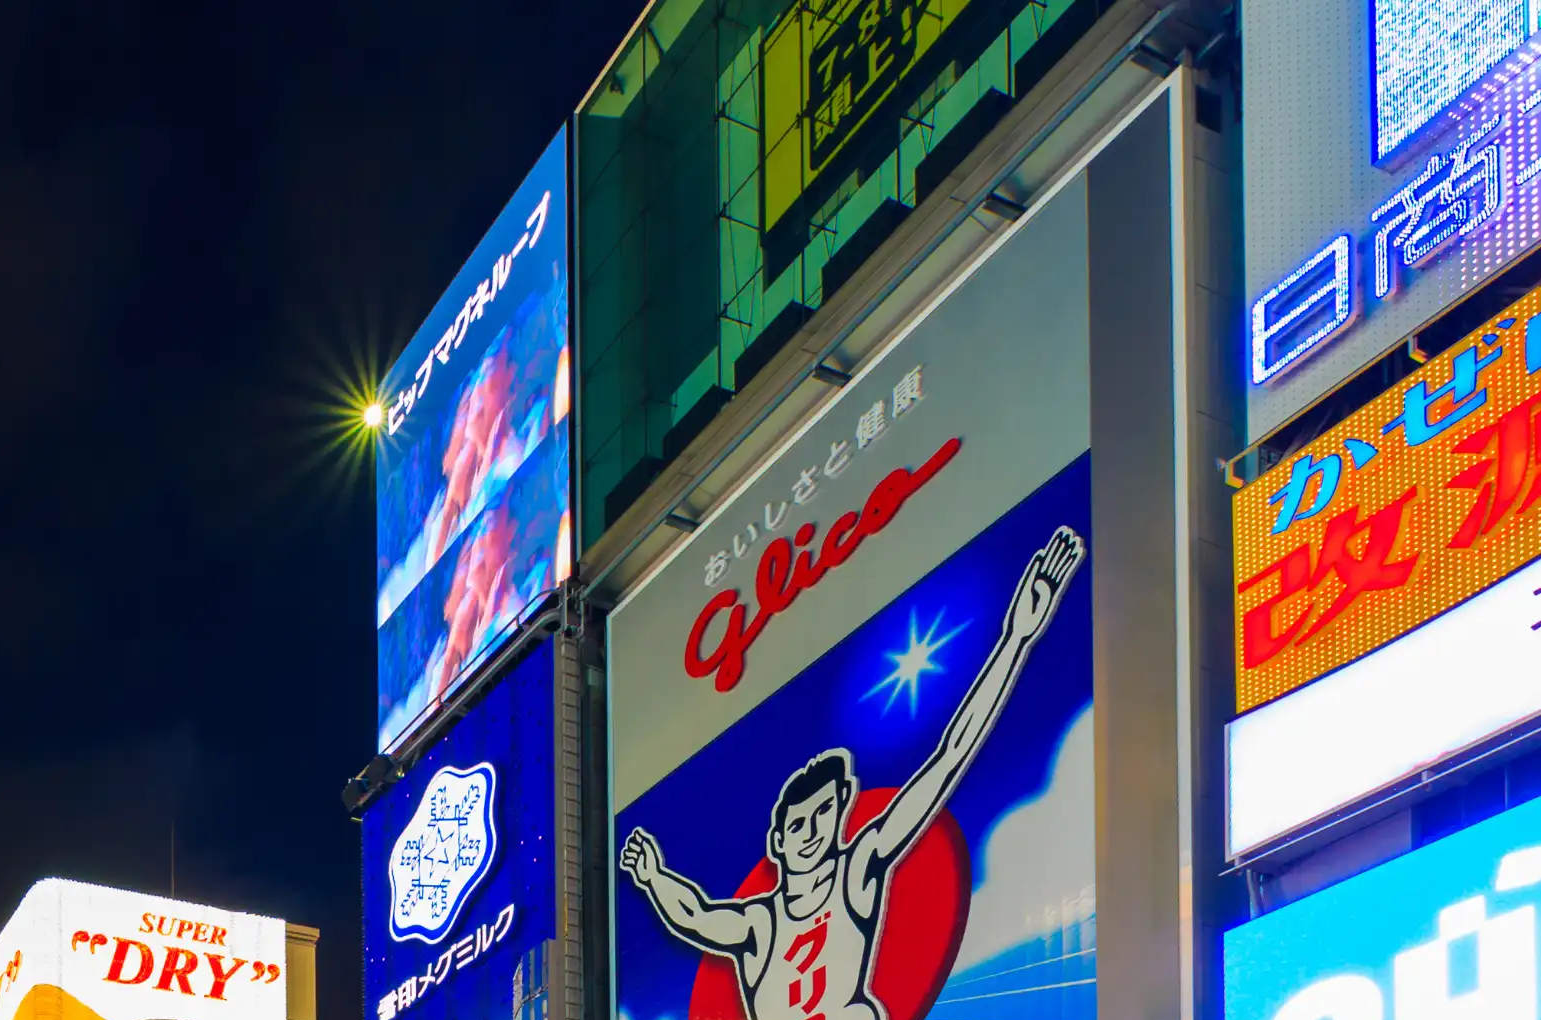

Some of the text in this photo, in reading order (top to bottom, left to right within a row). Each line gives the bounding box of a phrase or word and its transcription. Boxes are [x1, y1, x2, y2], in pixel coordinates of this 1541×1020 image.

[1252, 88, 1541, 385] 日商
[704, 363, 926, 587] おいしさと健康
[1269, 312, 1541, 536] かぜ
[138, 912, 228, 947] SUPER
